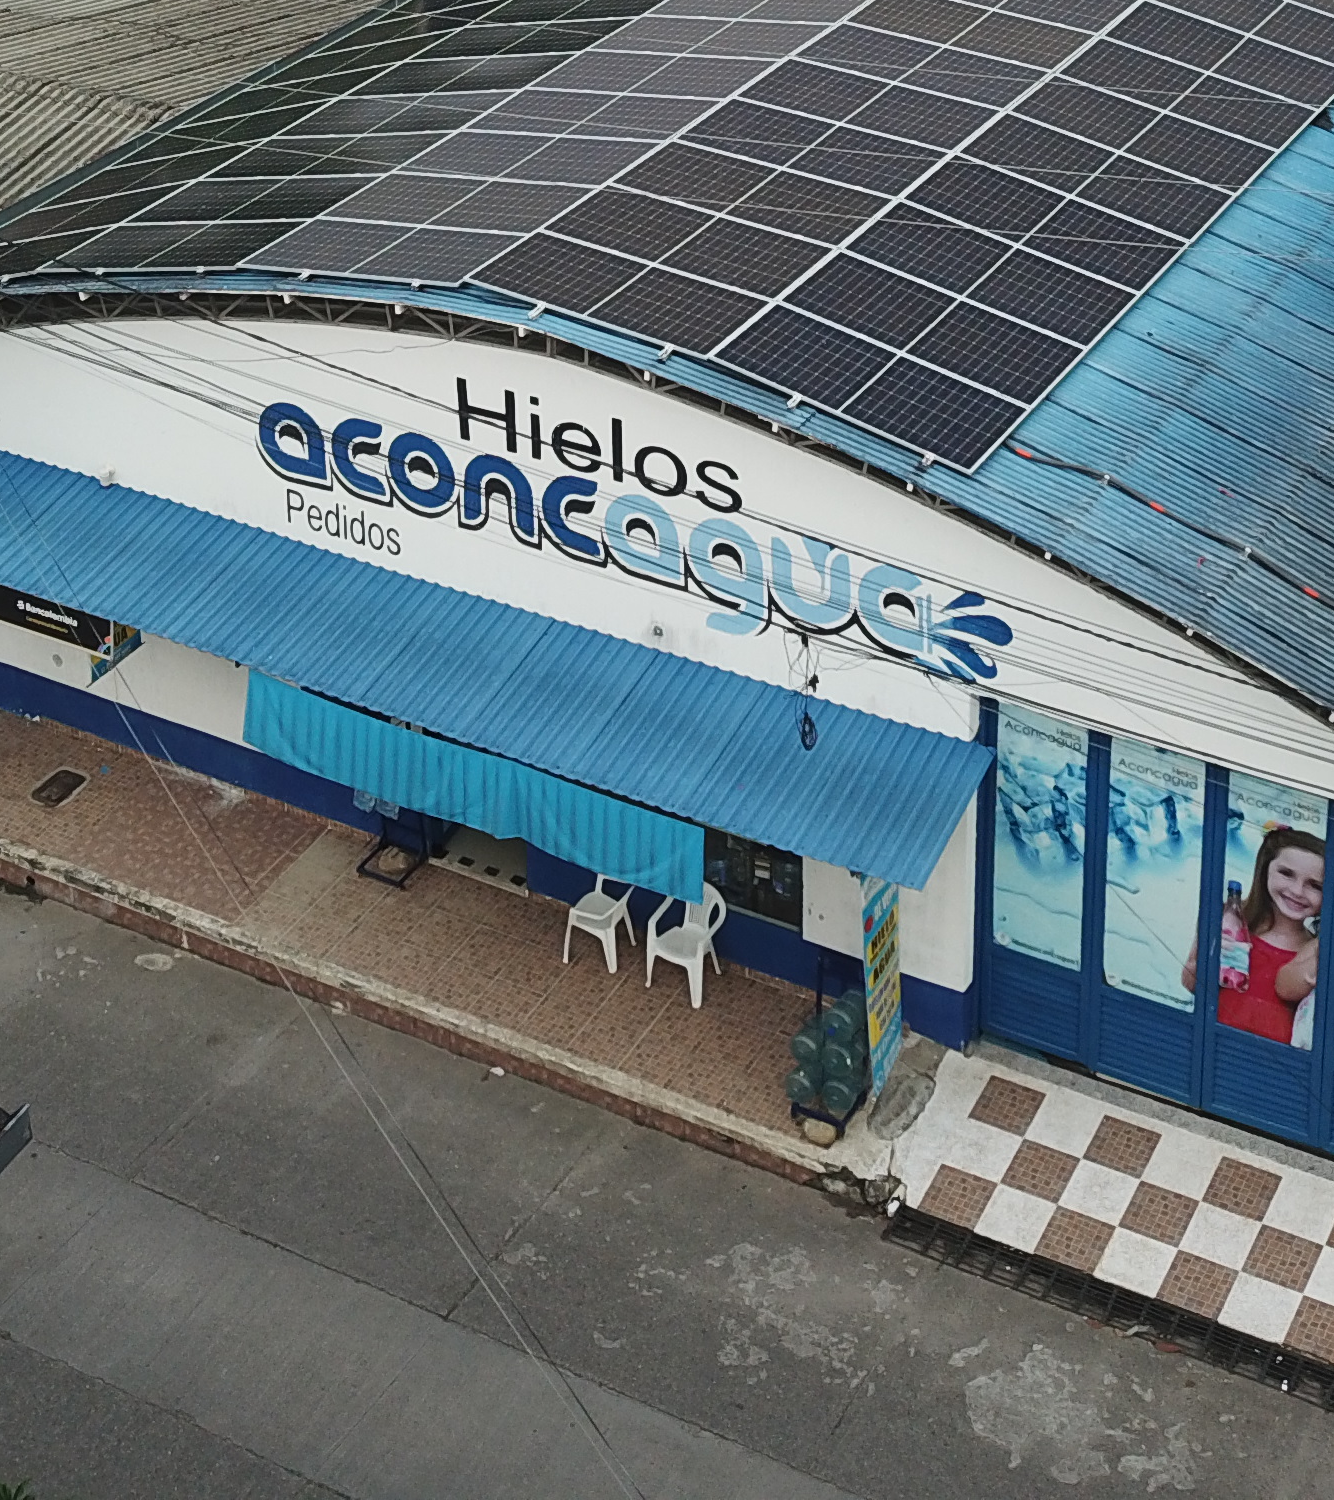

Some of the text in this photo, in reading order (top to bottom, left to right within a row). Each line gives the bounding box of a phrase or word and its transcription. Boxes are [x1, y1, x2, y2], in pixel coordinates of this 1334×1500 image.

[457, 376, 743, 514] Hielos
[257, 402, 937, 662] aconcagua
[286, 488, 401, 556] Pedidos
[1004, 720, 1082, 751] Aconcagua
[1118, 757, 1199, 790] Aconcagua
[1237, 792, 1321, 825] Aconcagua
